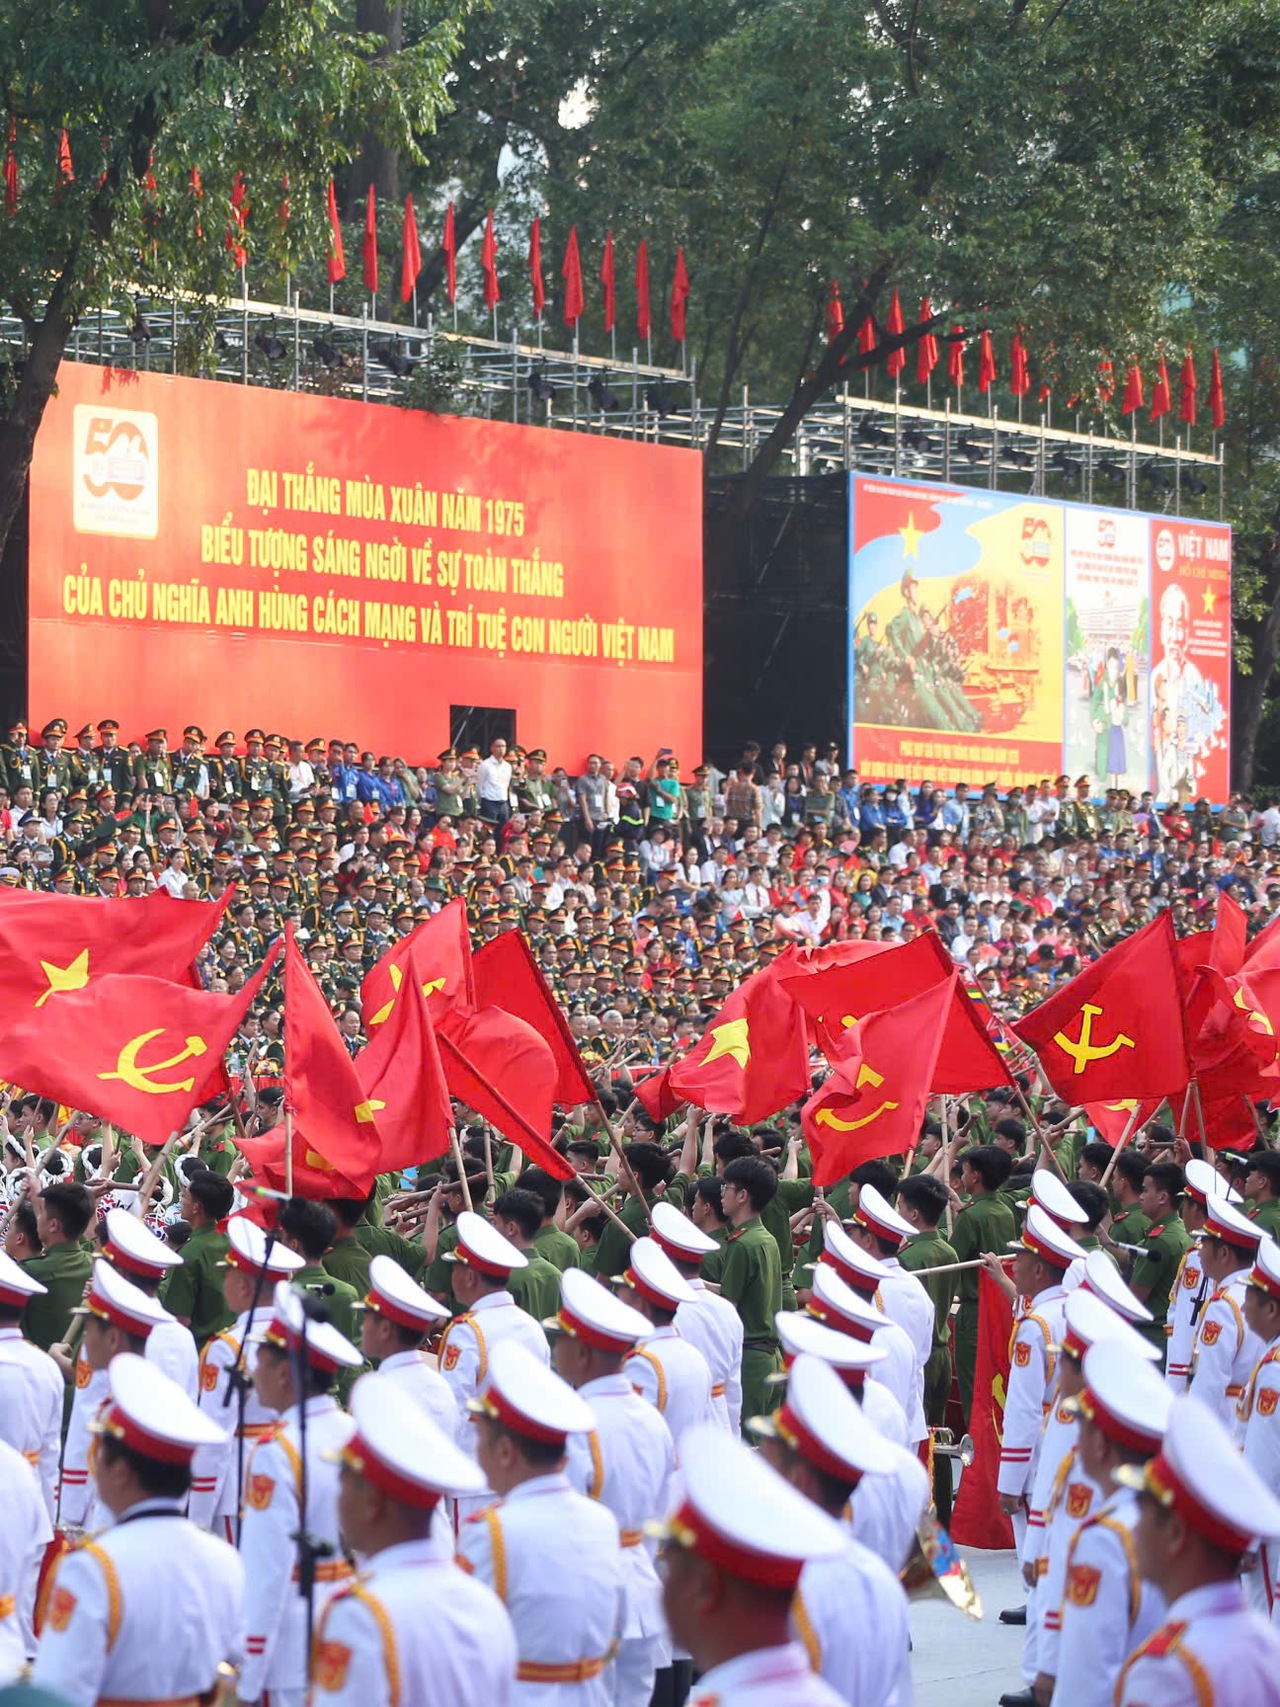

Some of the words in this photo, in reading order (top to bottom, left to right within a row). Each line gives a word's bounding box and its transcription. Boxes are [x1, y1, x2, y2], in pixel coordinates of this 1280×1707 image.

[246, 468, 278, 516] ĐẠI
[282, 461, 341, 516] THẮNG
[346, 474, 386, 521] MÙA
[390, 482, 438, 527] XUÂN
[442, 487, 481, 532] NĂM
[485, 498, 525, 537] 1975
[201, 511, 244, 566] BIỂU
[248, 527, 308, 578] TƯỢNG
[312, 529, 361, 578] SÁNG
[365, 536, 407, 583] NGỜI
[411, 537, 433, 586] VỀ
[436, 548, 462, 596] SỰ
[464, 547, 507, 595] TOÀN
[510, 546, 564, 598] THẮNG
[1178, 529, 1203, 563] VIỆT
[1204, 536, 1229, 562] NAM
[63, 562, 103, 617] CỦA
[108, 568, 148, 620] CHỦ
[152, 577, 211, 625] NGHĨA
[215, 587, 254, 628] ANH
[258, 584, 308, 632] HÙNG
[312, 589, 360, 638] CÁCH
[364, 601, 417, 648] MẠNG
[420, 600, 443, 645] VÀ
[446, 603, 473, 648] TRÍ
[477, 606, 507, 659] TUỆ
[510, 614, 545, 654] CON
[549, 613, 598, 657] NGƯỜI
[601, 617, 634, 667] VIỆT
[637, 626, 675, 664] NAM
